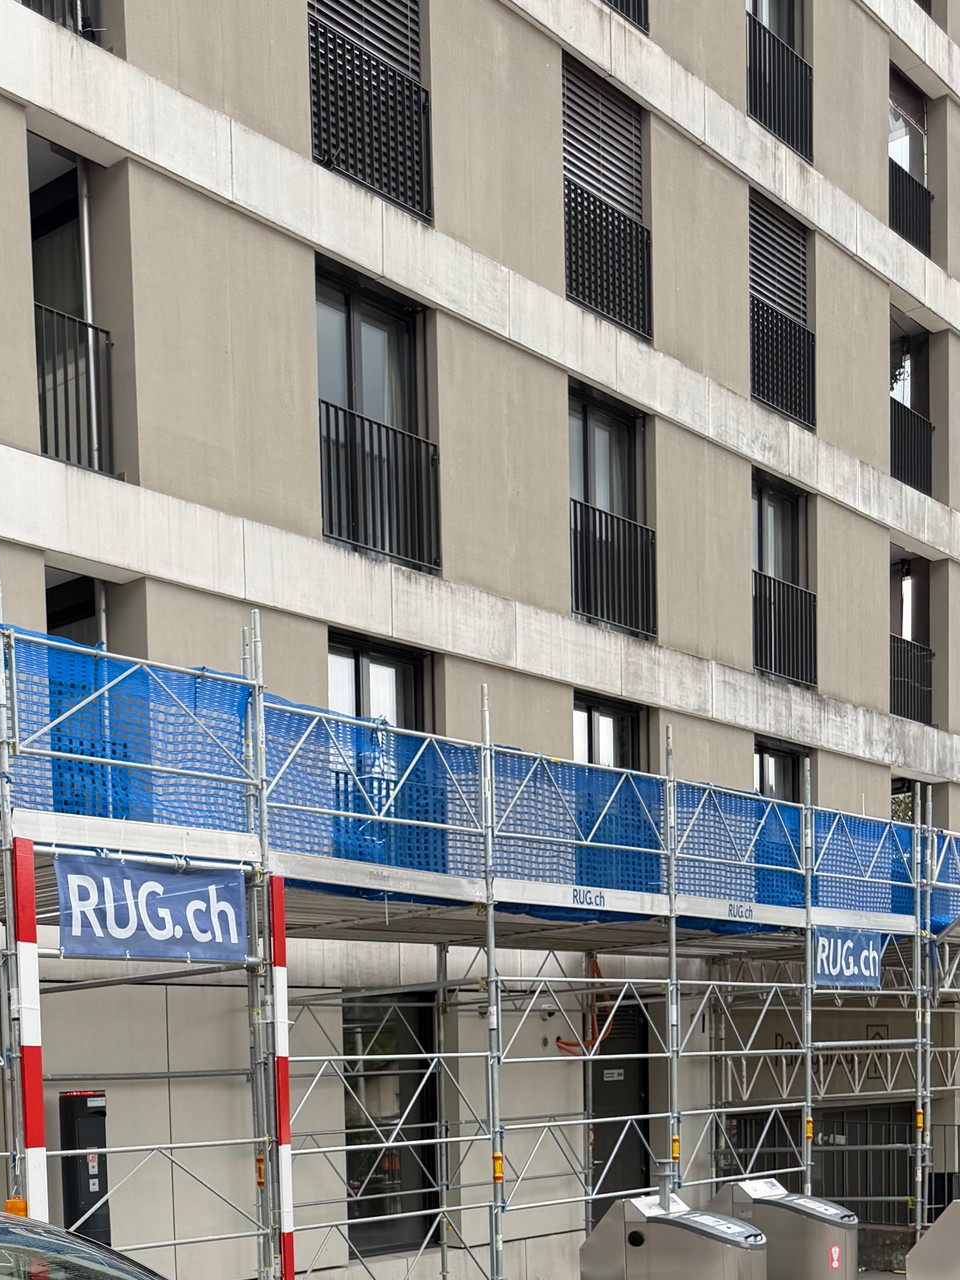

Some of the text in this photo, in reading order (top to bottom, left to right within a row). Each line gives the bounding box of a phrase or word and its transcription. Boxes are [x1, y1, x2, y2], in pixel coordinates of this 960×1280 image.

[67, 874, 239, 944] RUG.ch
[572, 888, 605, 907] RUG.ch
[728, 903, 753, 920] RUG.ch
[817, 936, 879, 977] RUG.ch
